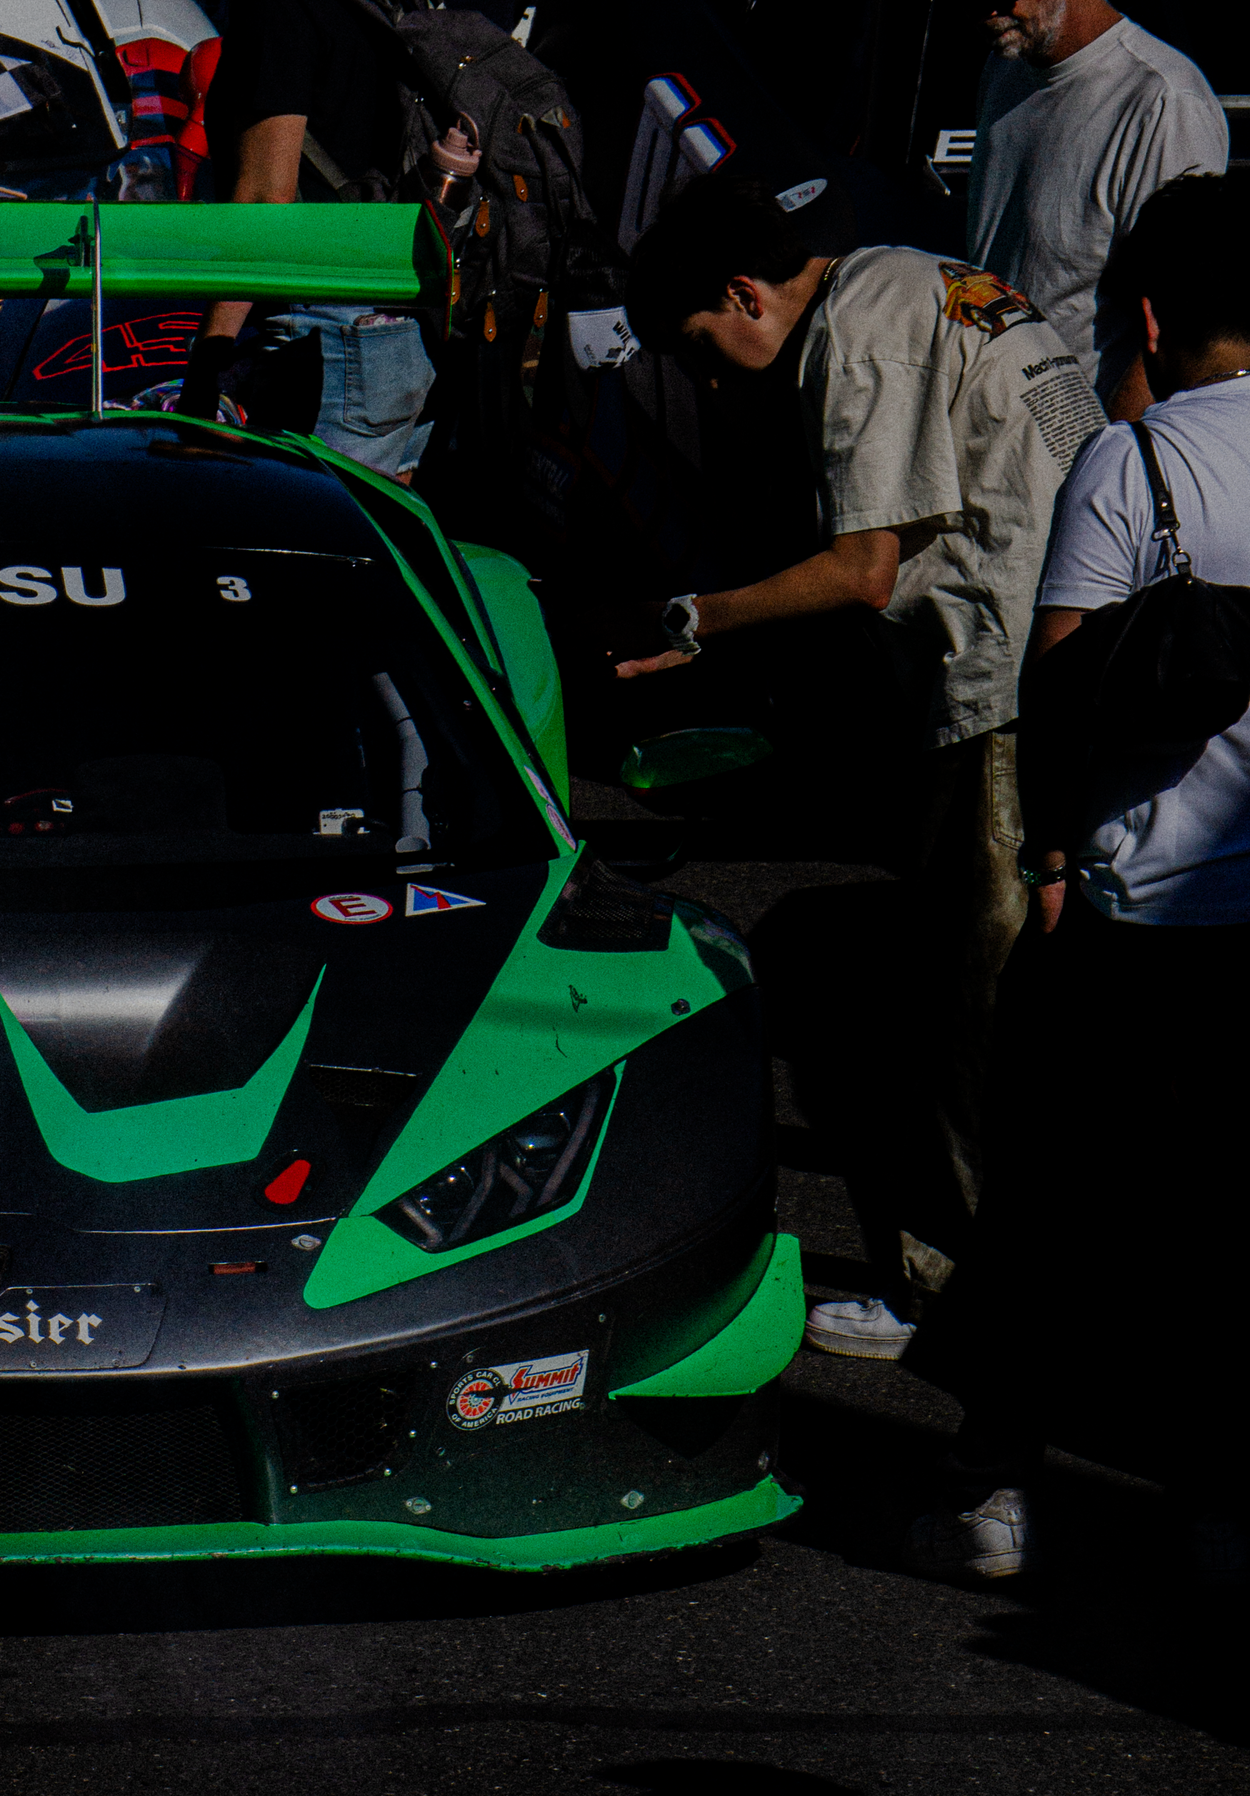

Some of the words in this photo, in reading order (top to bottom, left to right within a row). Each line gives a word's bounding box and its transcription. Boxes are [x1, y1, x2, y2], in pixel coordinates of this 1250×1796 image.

[215, 575, 252, 602] 3
[329, 897, 377, 917] E
[449, 1374, 474, 1405] SPORTS
[475, 1371, 494, 1379] CAR
[451, 1413, 462, 1422] OF
[496, 1407, 534, 1425] ROAD
[534, 1397, 581, 1418] RACING
